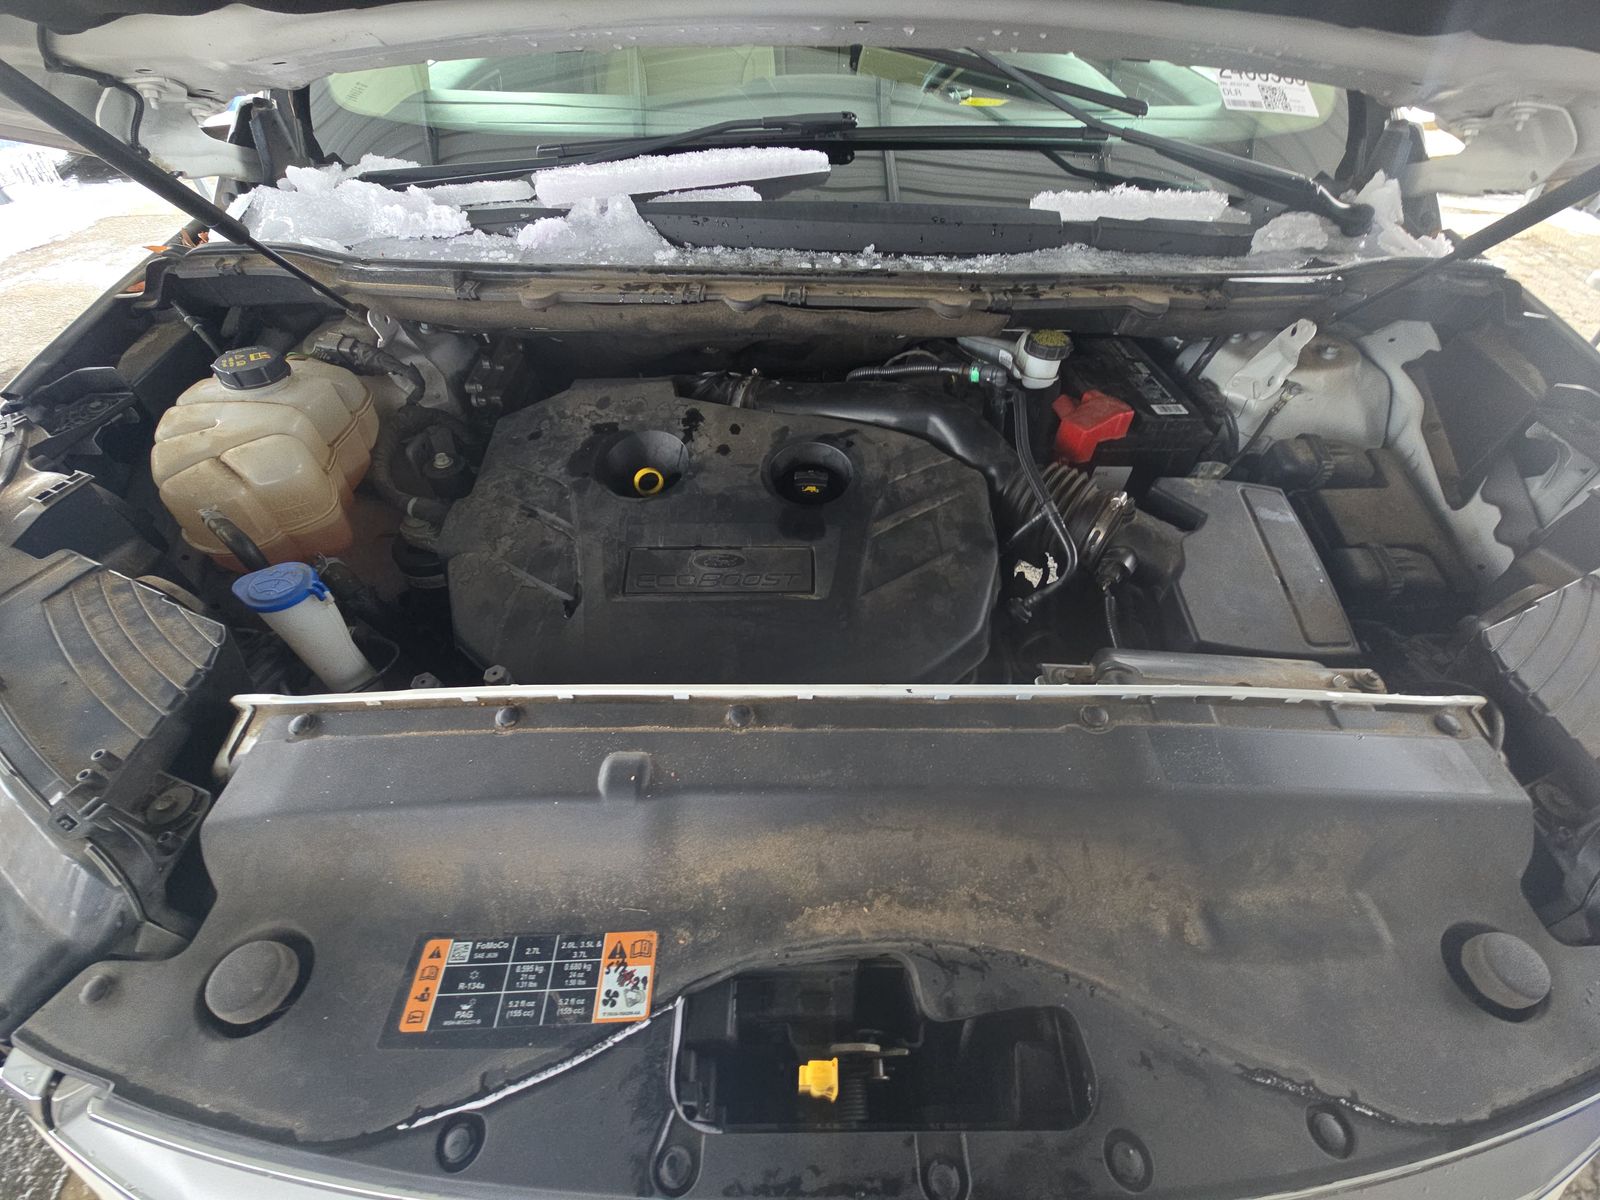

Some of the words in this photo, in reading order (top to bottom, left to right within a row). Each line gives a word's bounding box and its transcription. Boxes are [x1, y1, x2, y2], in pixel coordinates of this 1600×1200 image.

[475, 942, 509, 950] FoMoCo
[580, 940, 594, 948] 3.5L
[525, 947, 541, 955] 2.7L
[535, 965, 545, 974] kg
[583, 963, 592, 972] kg
[458, 982, 485, 990] R-134a
[508, 1000, 519, 1008] 5.2
[454, 1010, 474, 1019] PAG
